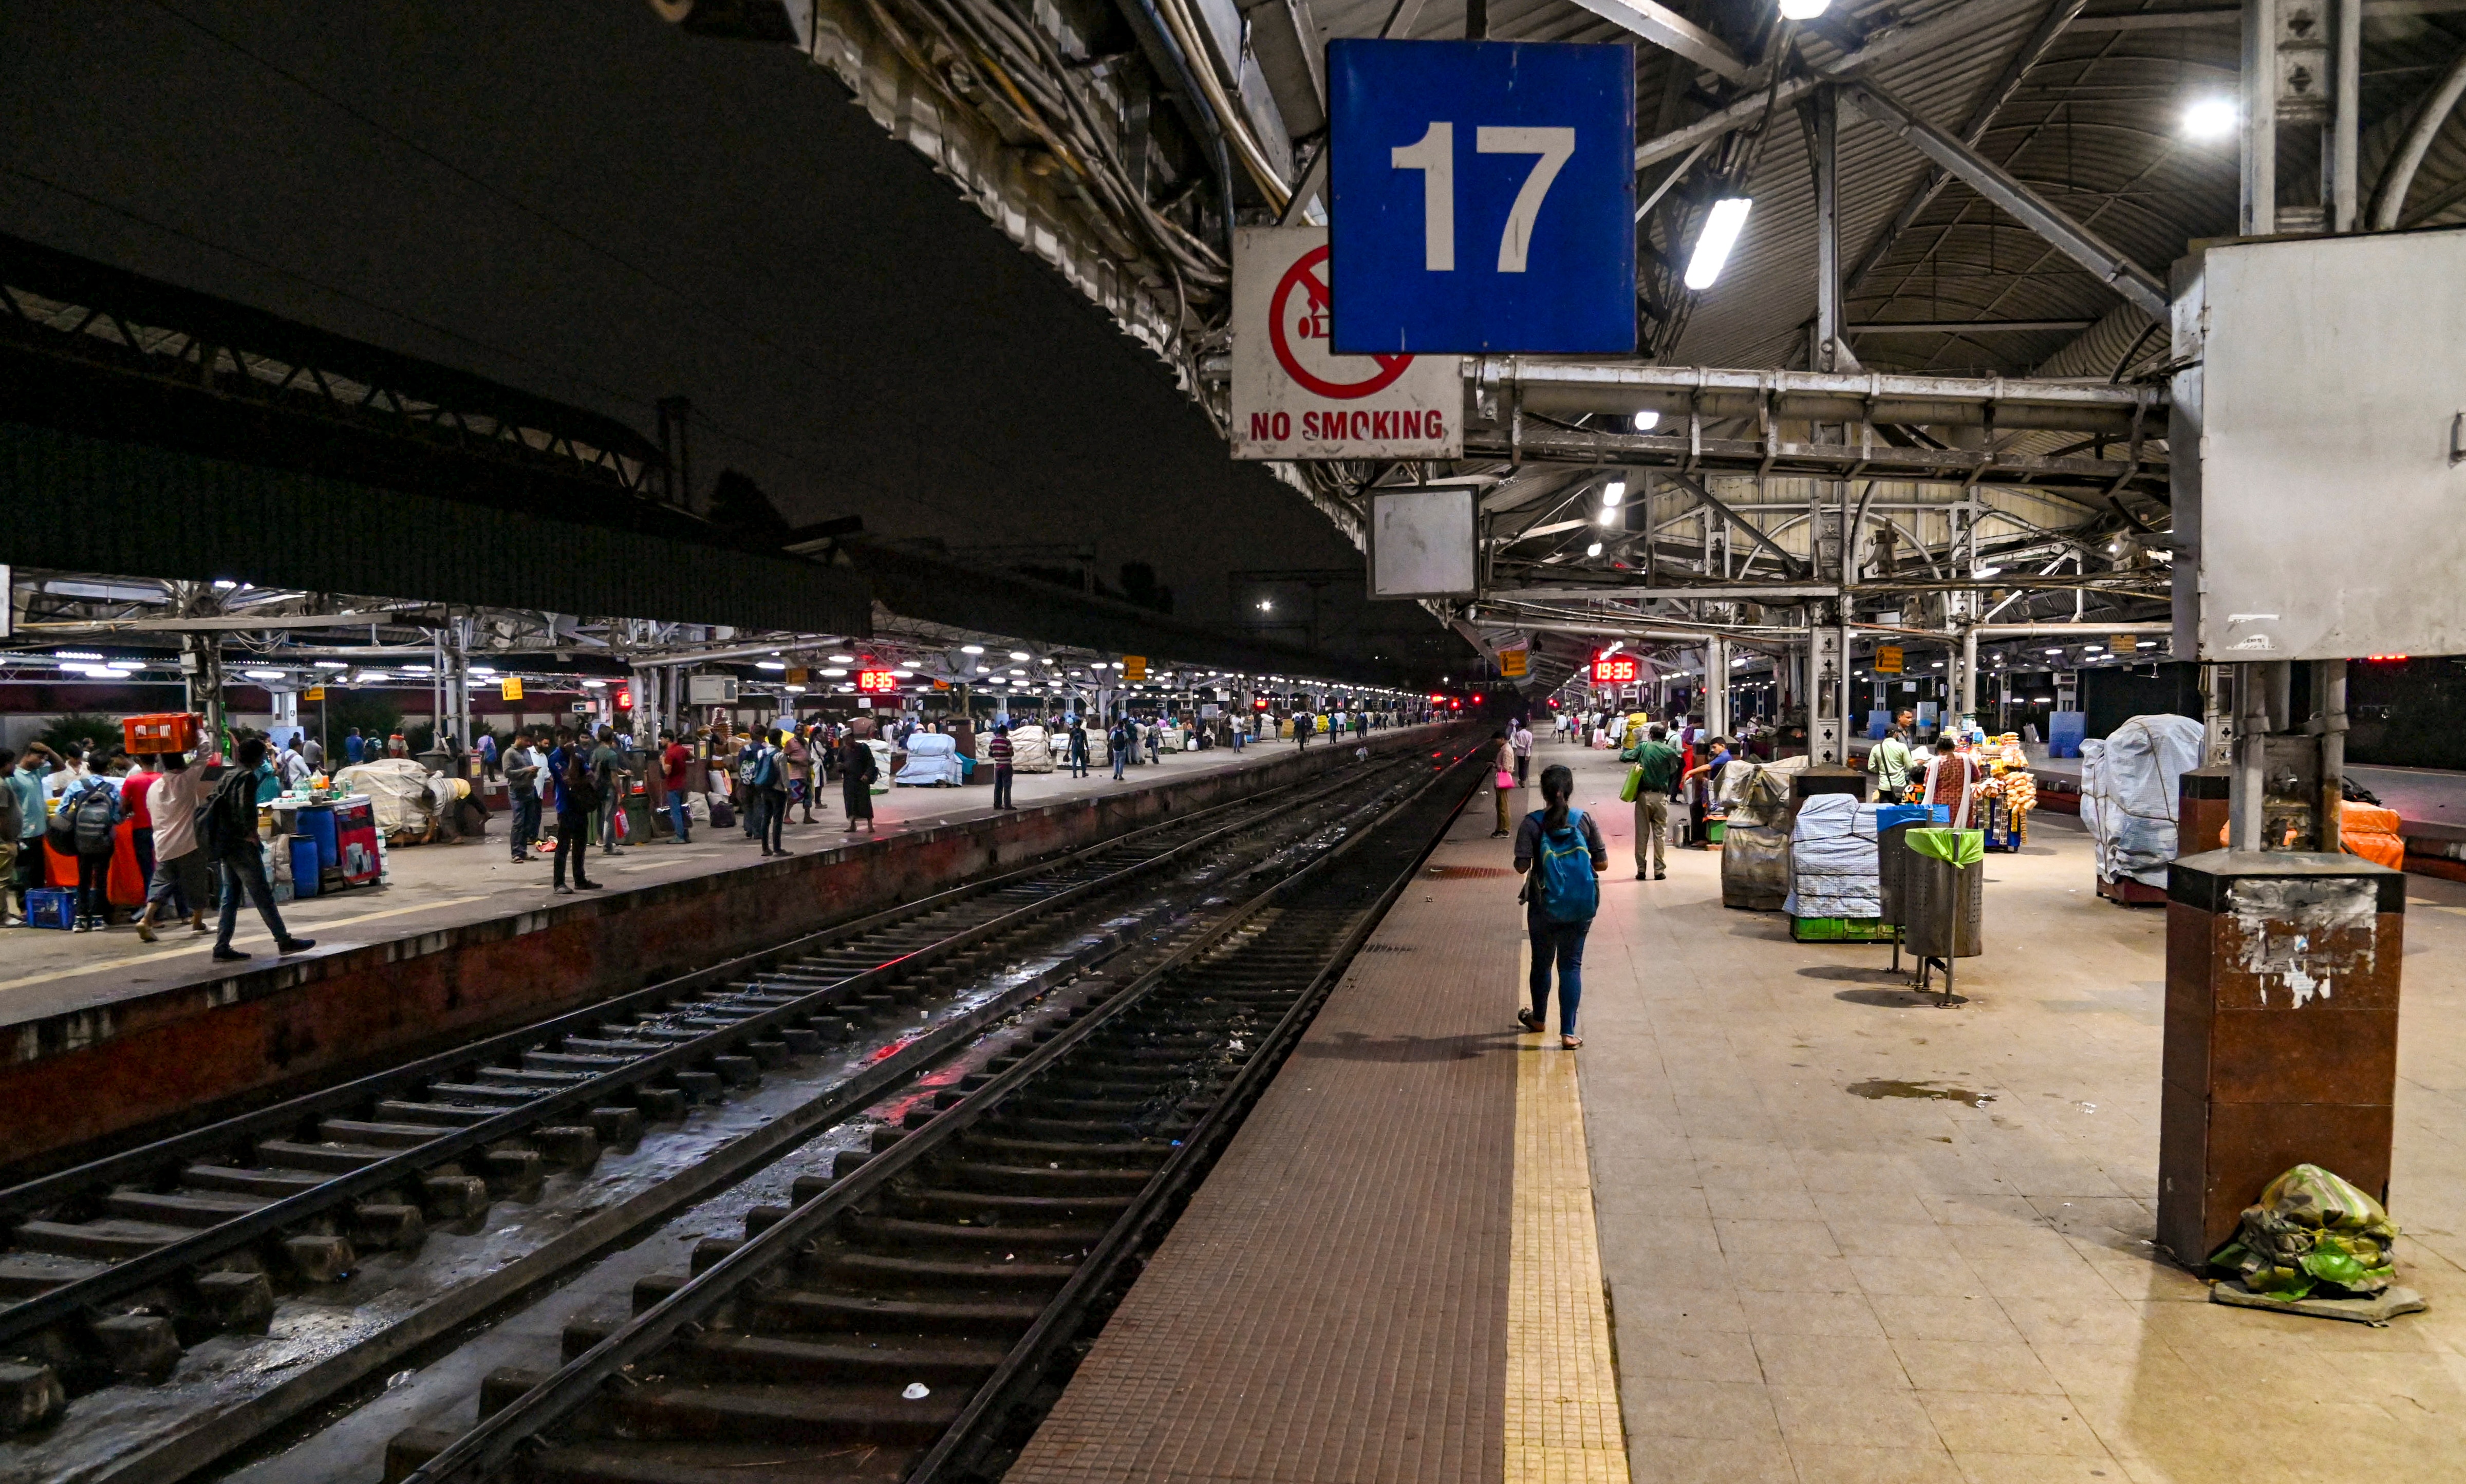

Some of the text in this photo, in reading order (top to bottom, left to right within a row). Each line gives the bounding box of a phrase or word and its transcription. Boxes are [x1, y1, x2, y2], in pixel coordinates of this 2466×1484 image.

[1391, 121, 1575, 272] 17
[1250, 410, 1443, 441] NO SMOKING
[862, 672, 893, 688] 19:35
[1597, 662, 1633, 679] 19:35
